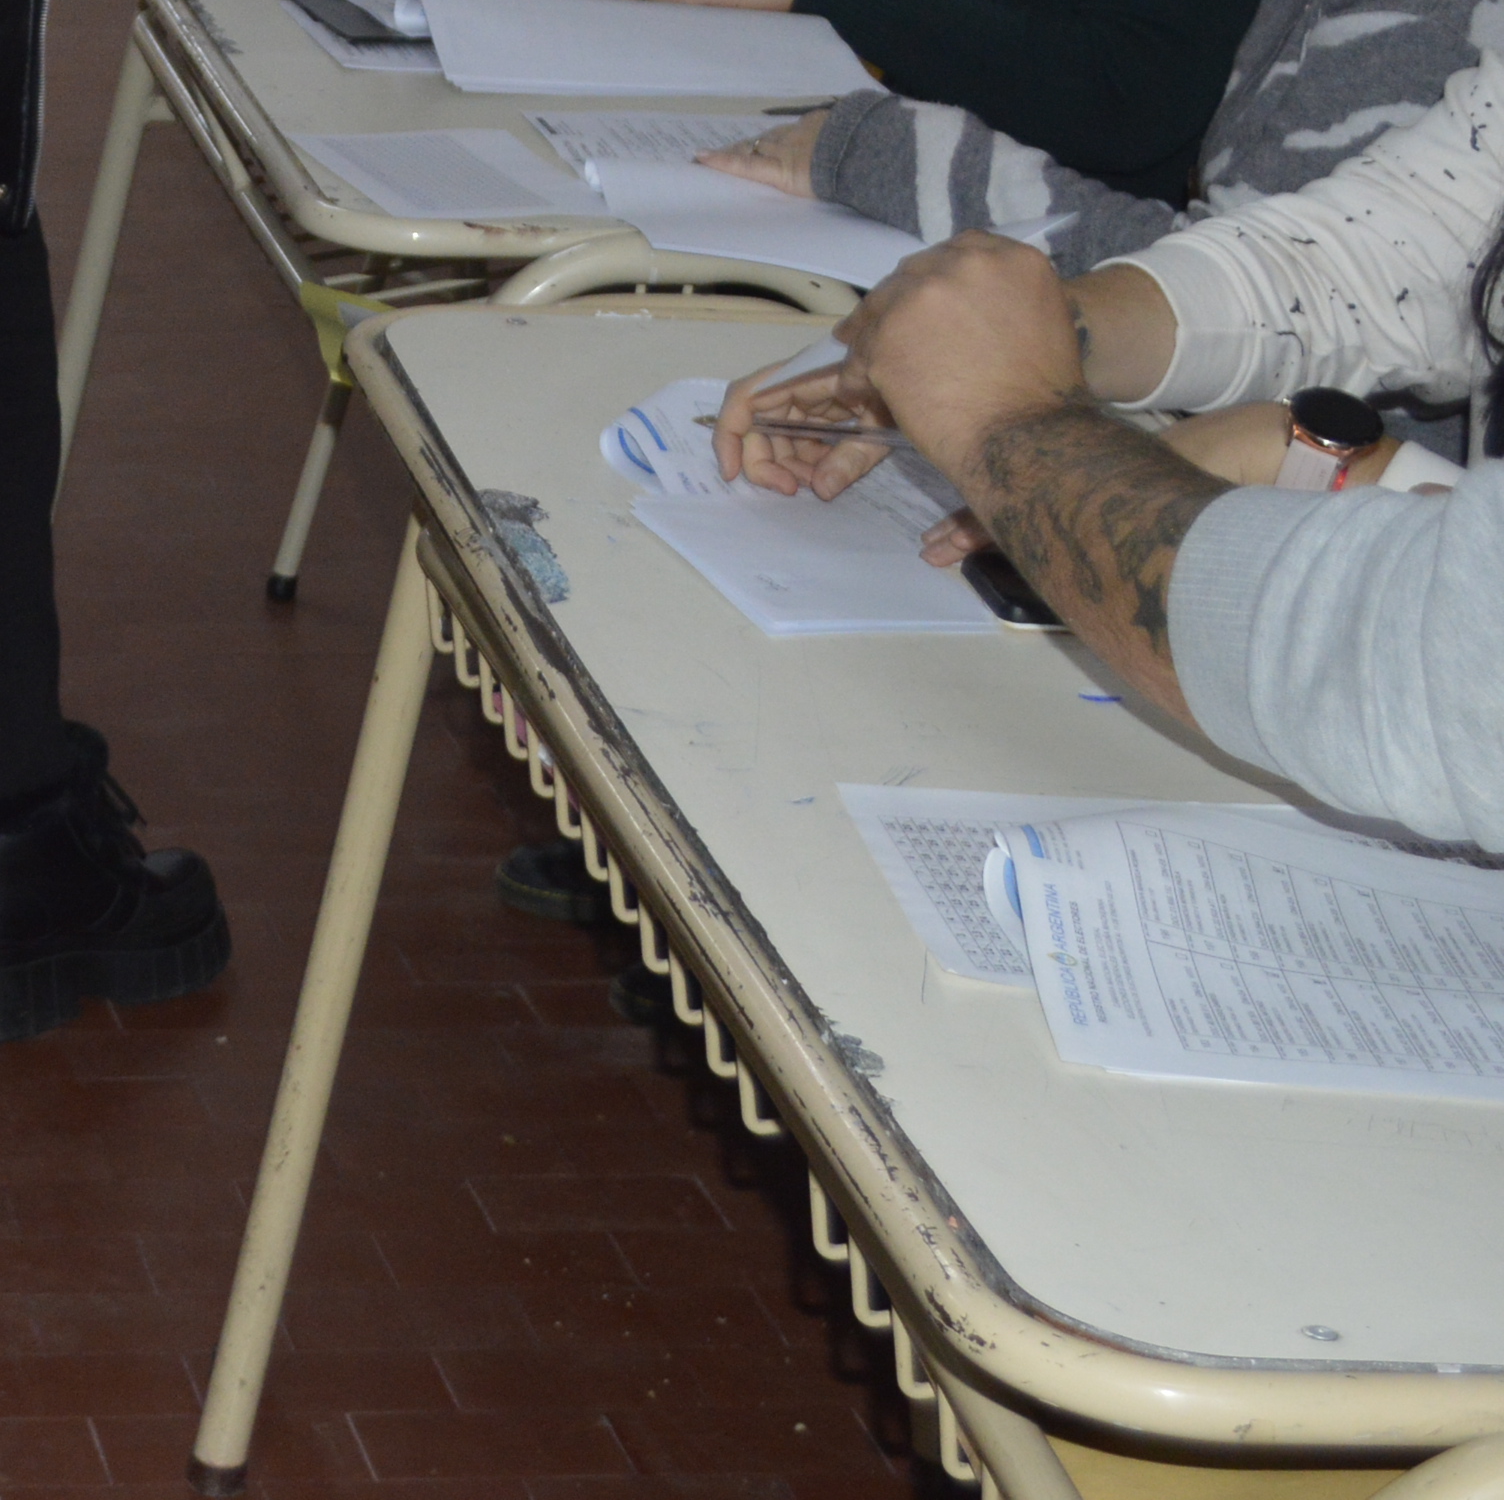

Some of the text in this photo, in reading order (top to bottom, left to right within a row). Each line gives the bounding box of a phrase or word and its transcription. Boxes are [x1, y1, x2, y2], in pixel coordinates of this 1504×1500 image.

[1044, 883, 1067, 951] ARGENTINA
[1069, 901, 1086, 944] ELECTORES
[1059, 967, 1088, 1026] REPÚBLICA
